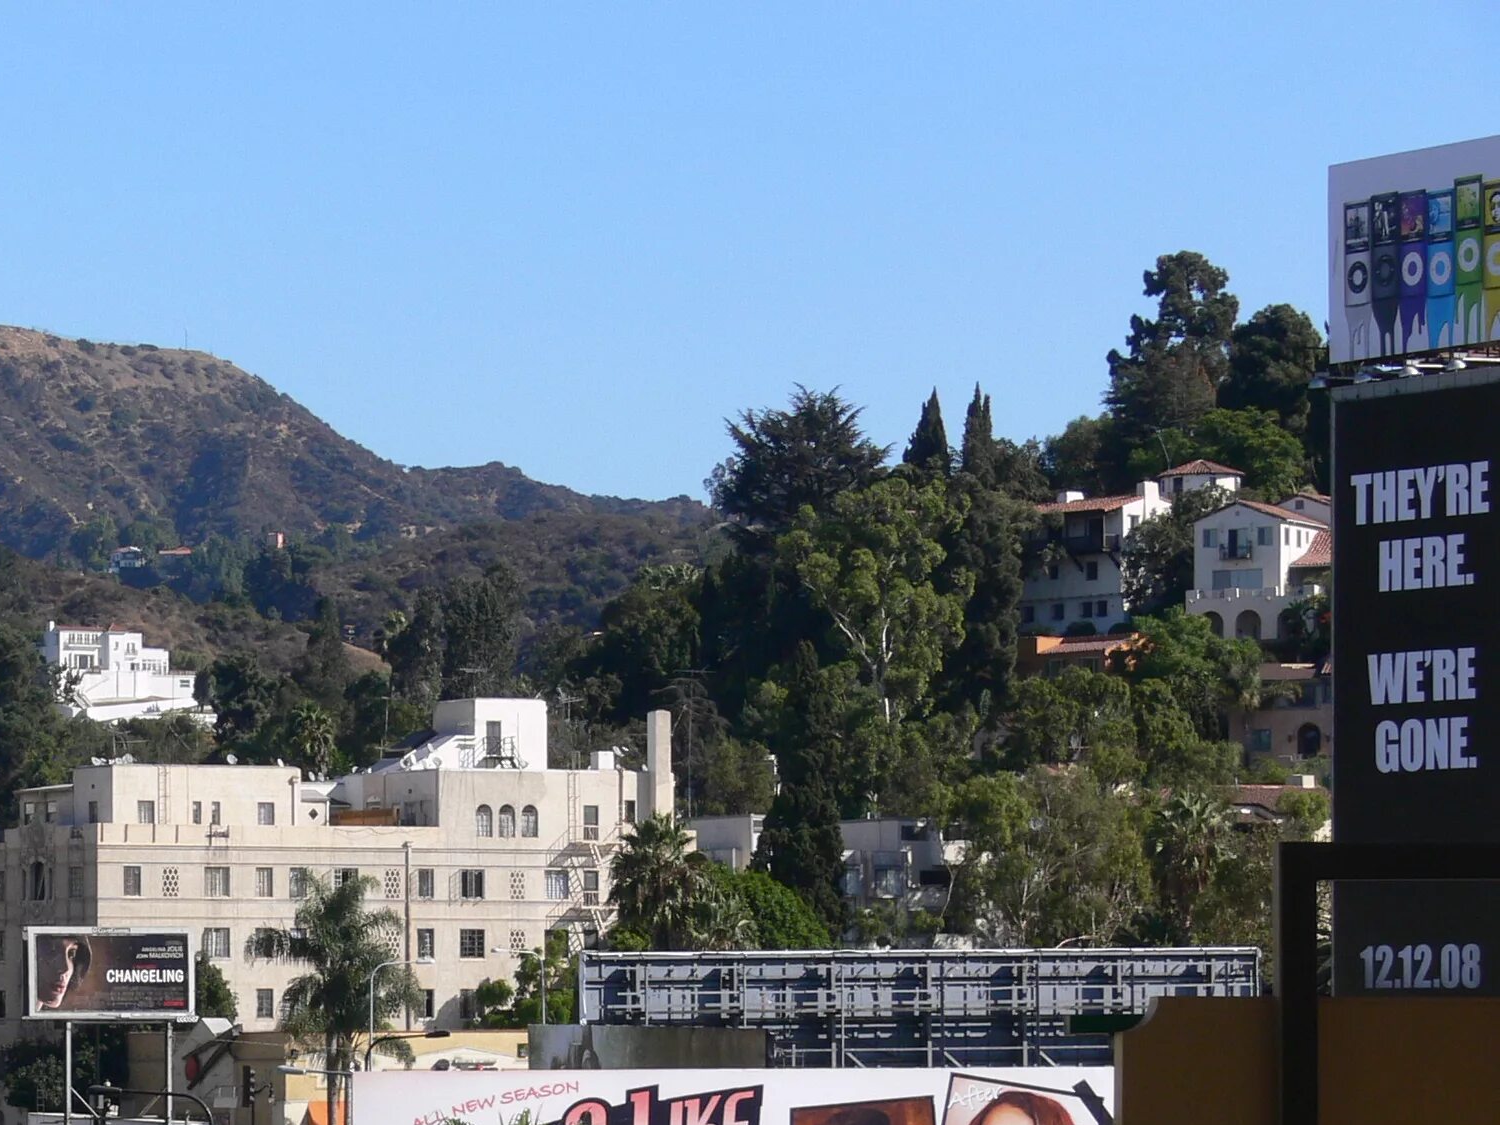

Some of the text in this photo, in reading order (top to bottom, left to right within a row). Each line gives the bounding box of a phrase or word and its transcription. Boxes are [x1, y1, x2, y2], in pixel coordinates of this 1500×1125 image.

[1351, 460, 1490, 526] THEY'RE
[1378, 533, 1475, 593] HERE.
[1367, 647, 1477, 706] WE'RE
[1375, 716, 1478, 774] GONE.
[106, 969, 184, 983] CHANGELING
[1359, 943, 1482, 989] 12.12.08
[452, 1095, 496, 1118] NEW
[500, 1081, 580, 1105] SEASON
[948, 1085, 1003, 1109] After
